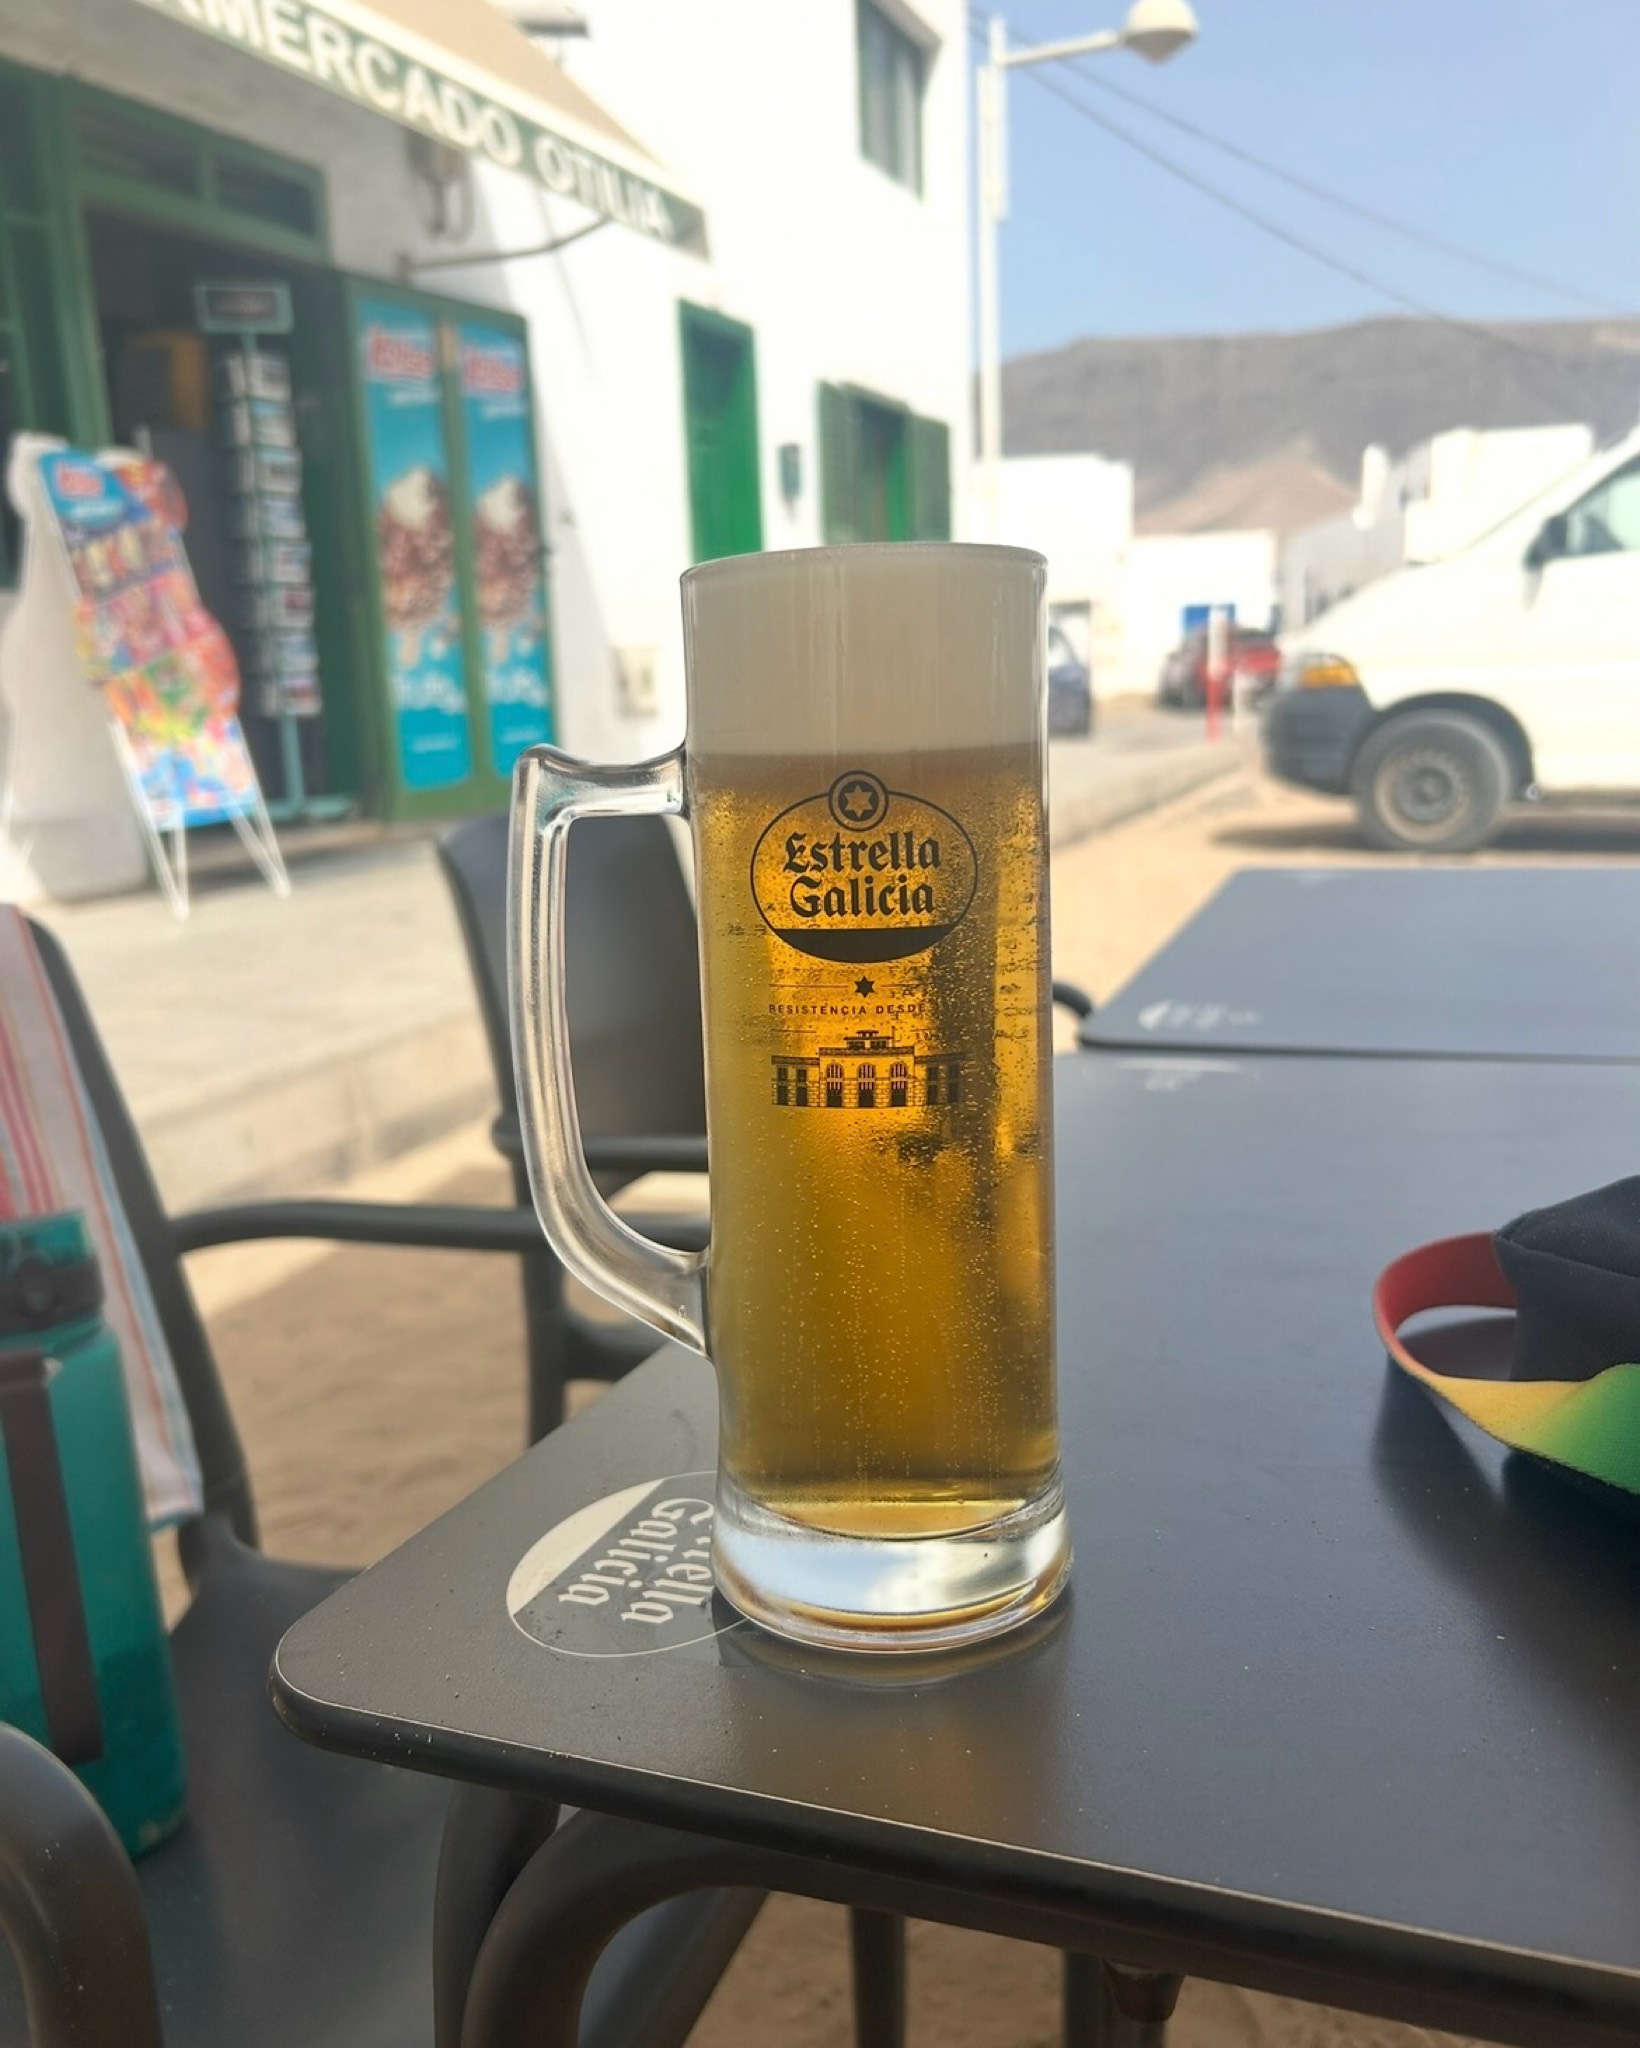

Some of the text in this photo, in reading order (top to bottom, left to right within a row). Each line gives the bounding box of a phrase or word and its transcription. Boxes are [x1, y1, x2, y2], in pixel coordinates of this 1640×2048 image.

[172, 0, 522, 169] MERCADO
[783, 830, 941, 873] Estrella
[790, 874, 935, 918] Galicia
[769, 1003, 926, 1015] RESISTENCIA DESDE
[558, 1498, 714, 1606] Galicia
